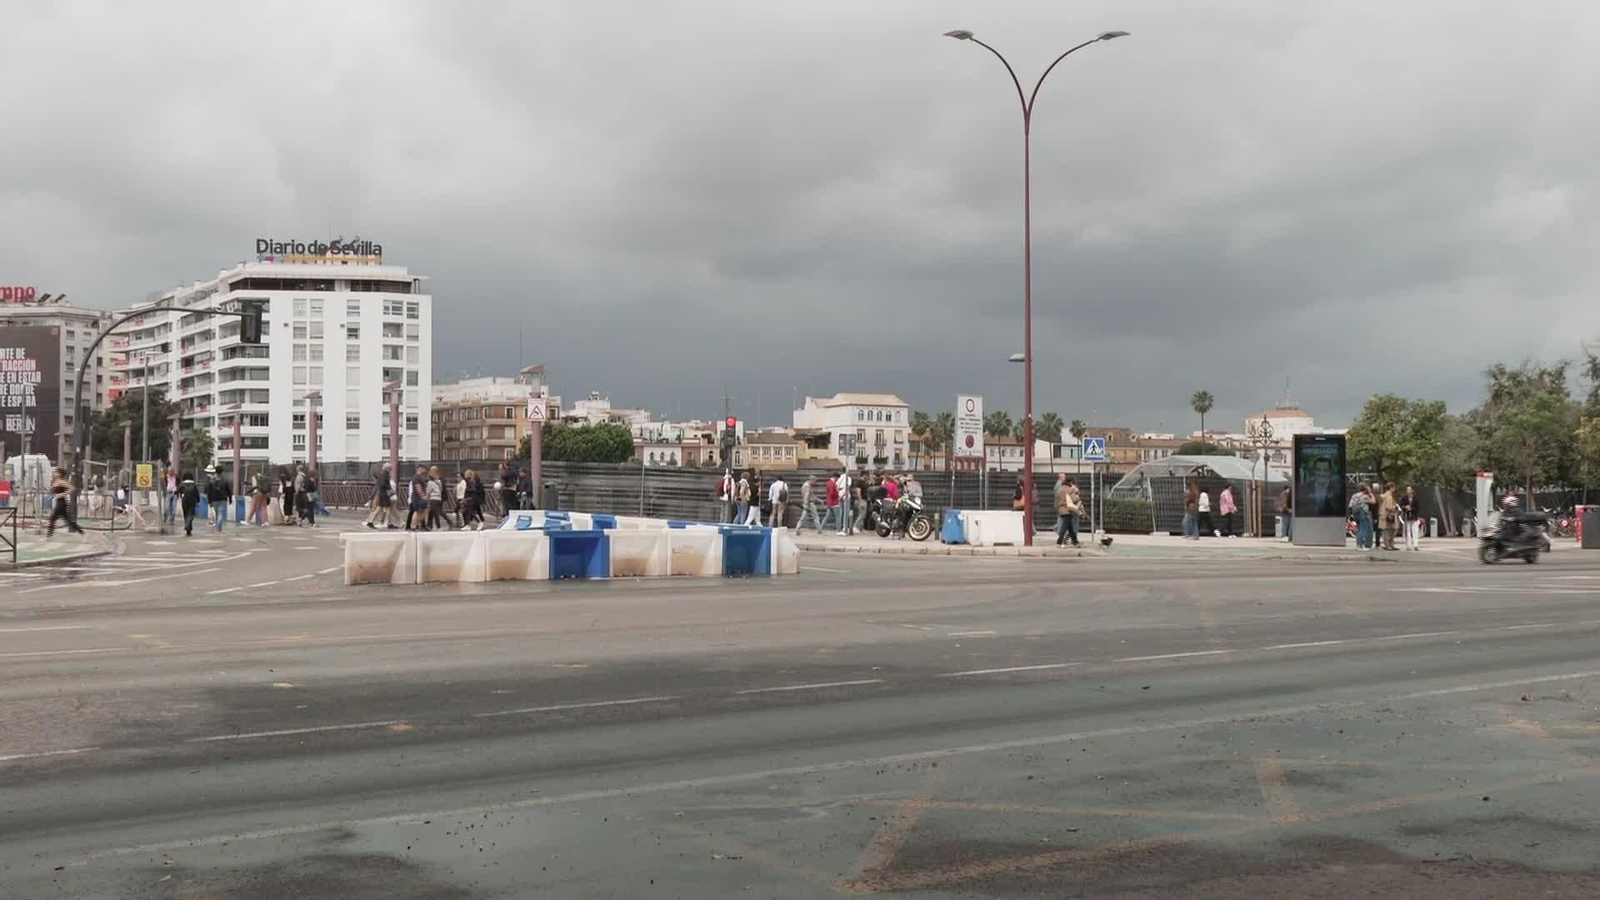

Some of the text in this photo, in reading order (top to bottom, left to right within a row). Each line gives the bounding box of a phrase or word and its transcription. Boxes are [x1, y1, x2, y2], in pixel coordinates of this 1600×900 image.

[256, 239, 305, 254] Diario
[330, 240, 382, 256] Sevilla
[16, 348, 25, 359] DE
[7, 371, 17, 383] EN
[8, 395, 36, 407] ESPRA
[6, 415, 35, 431] BERÍN
